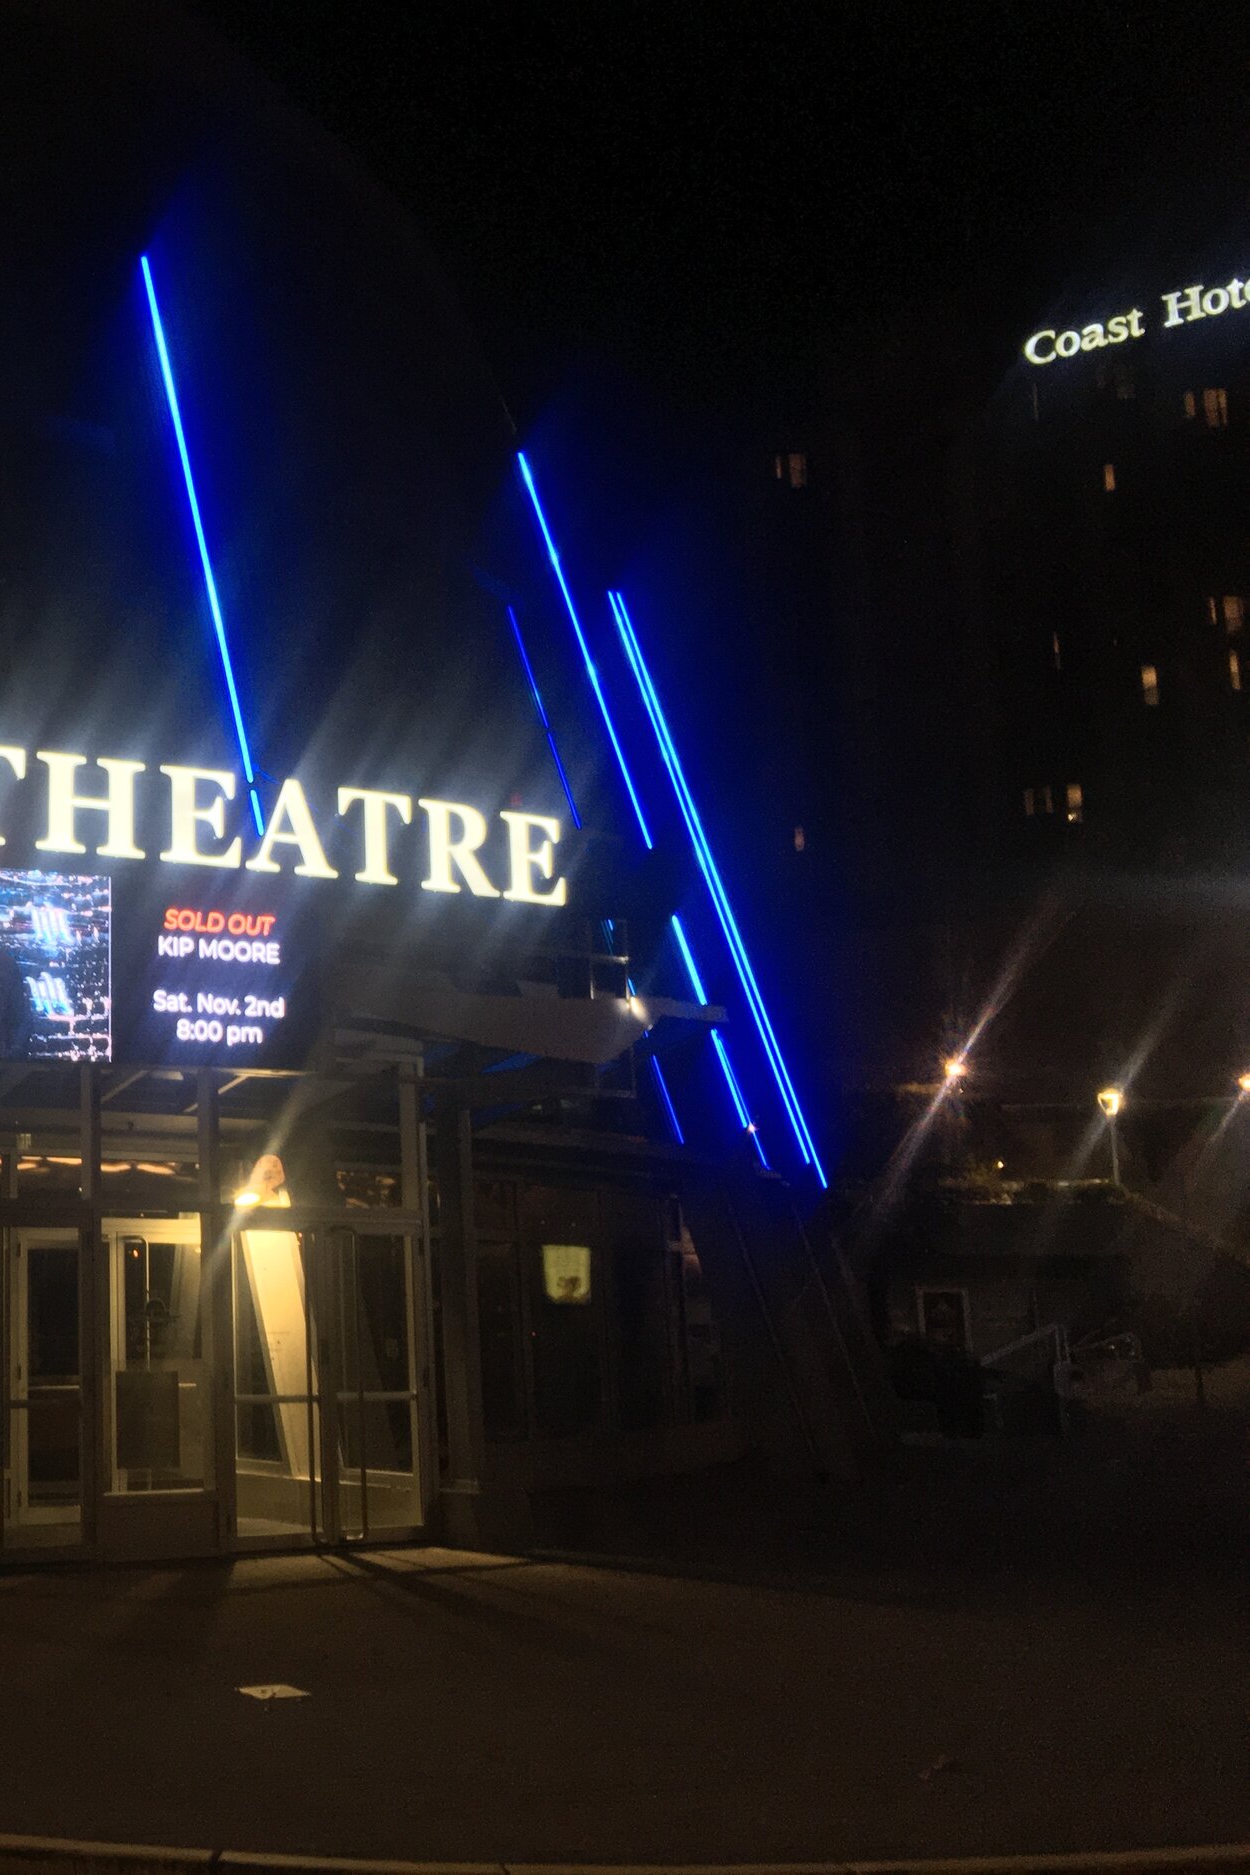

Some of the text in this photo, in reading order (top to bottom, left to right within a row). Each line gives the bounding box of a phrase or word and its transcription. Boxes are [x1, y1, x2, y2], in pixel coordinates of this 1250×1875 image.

[1025, 279, 1250, 364] Coast Hot
[164, 908, 276, 936] SOLD OUT
[158, 936, 281, 965] KIP MOORE
[154, 990, 285, 1018] Sat. Nov. 2nd
[176, 1018, 263, 1046] 8:00 pm
